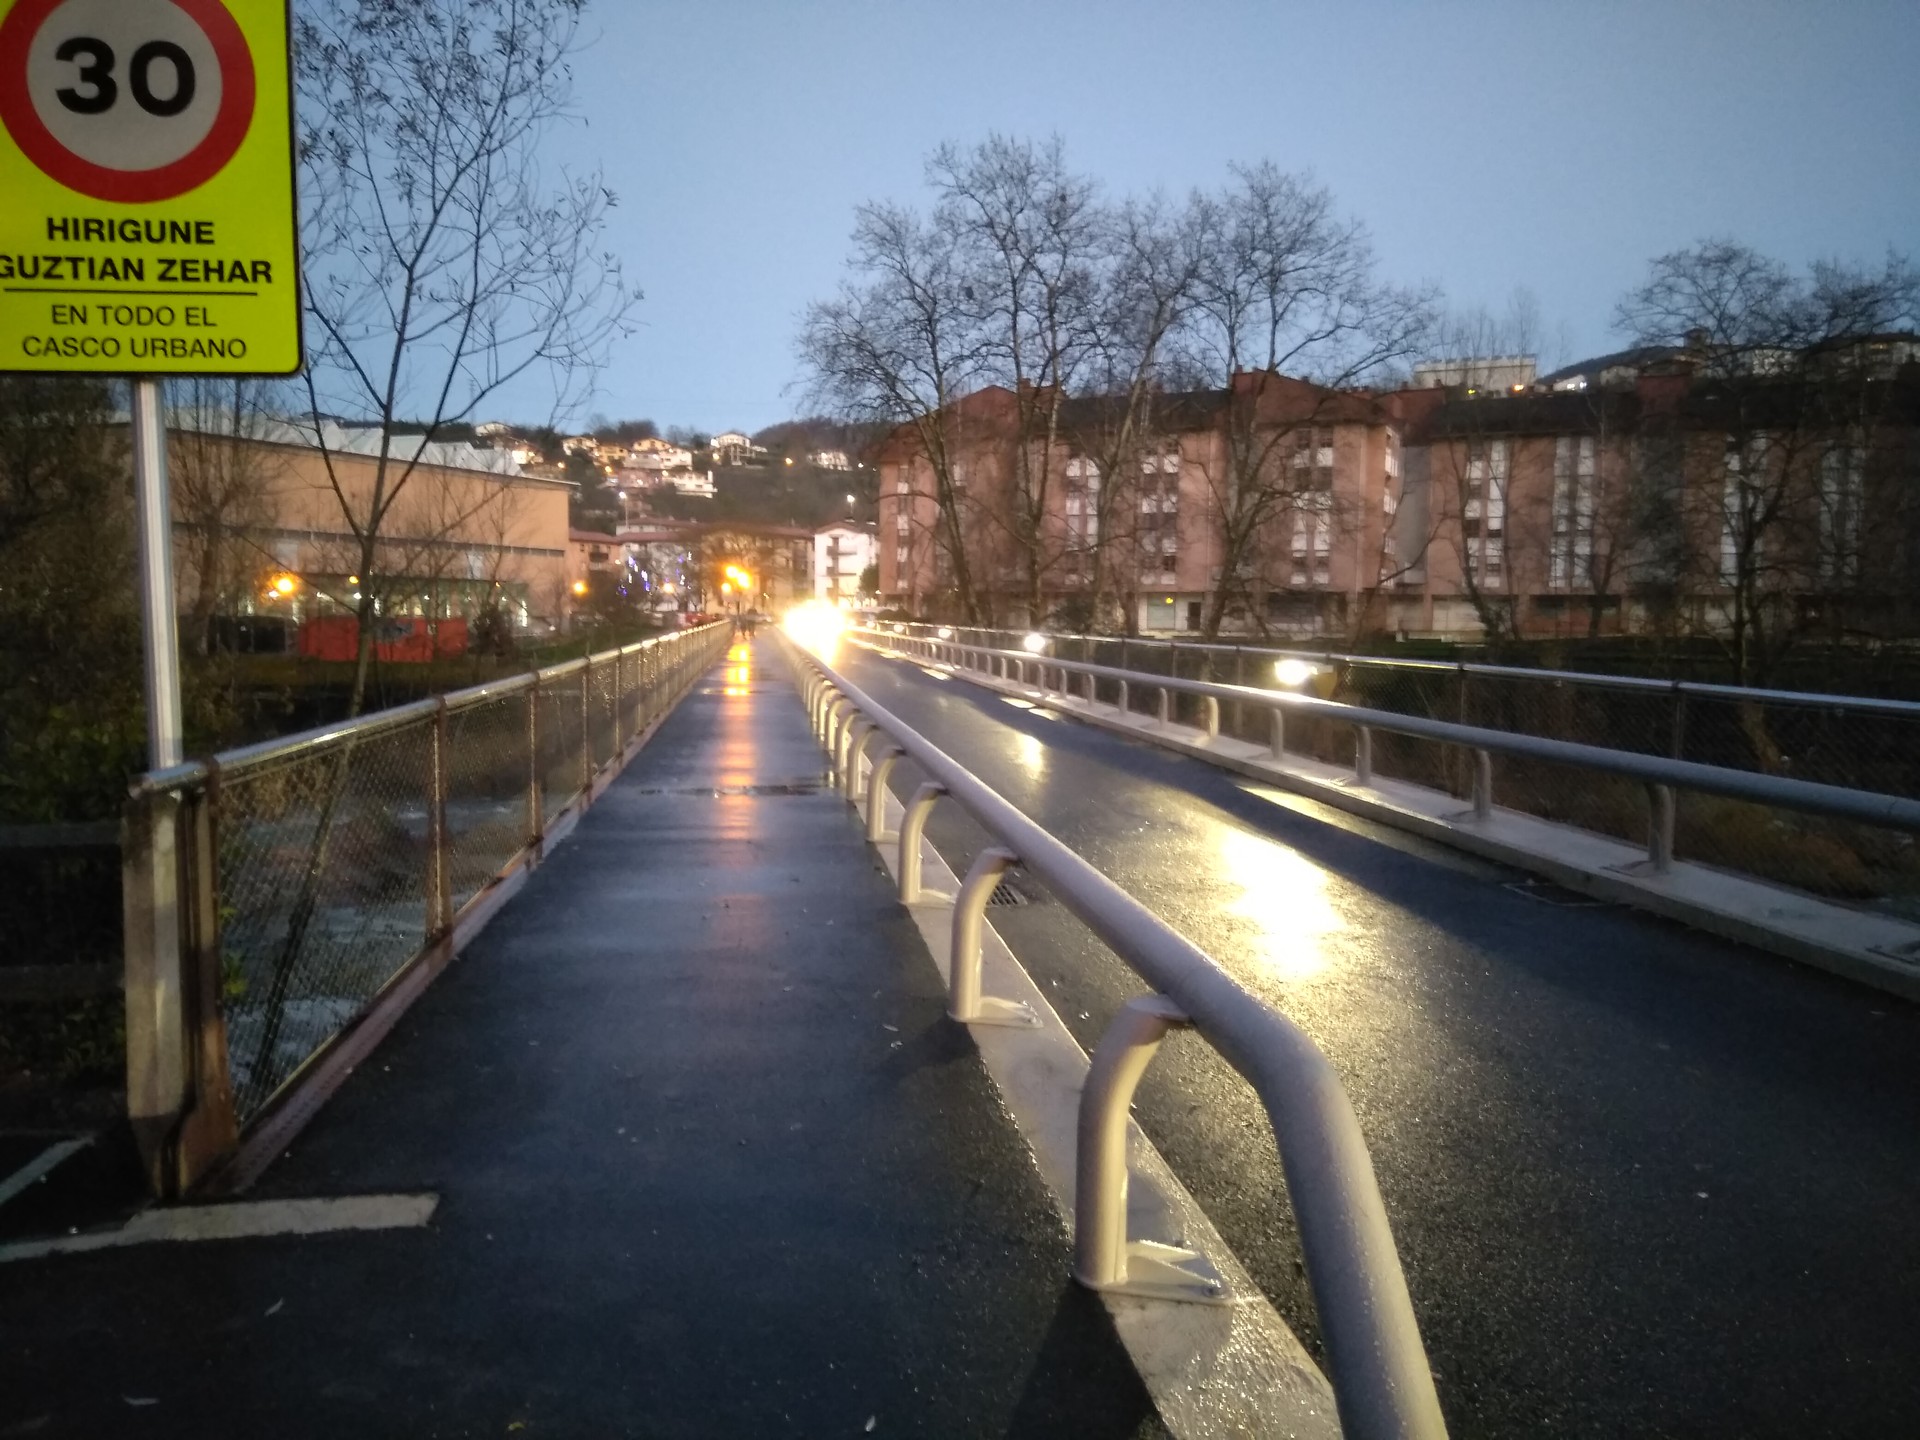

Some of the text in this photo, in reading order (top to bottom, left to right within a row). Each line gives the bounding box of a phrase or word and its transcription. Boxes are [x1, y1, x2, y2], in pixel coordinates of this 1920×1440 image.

[55, 37, 196, 117] 30
[47, 217, 215, 245] HIRIGUNE
[0, 255, 273, 284] GUZTIAN ZEHAR
[51, 305, 217, 327] EN TODO EL
[22, 336, 247, 359] CASCO URBANO
